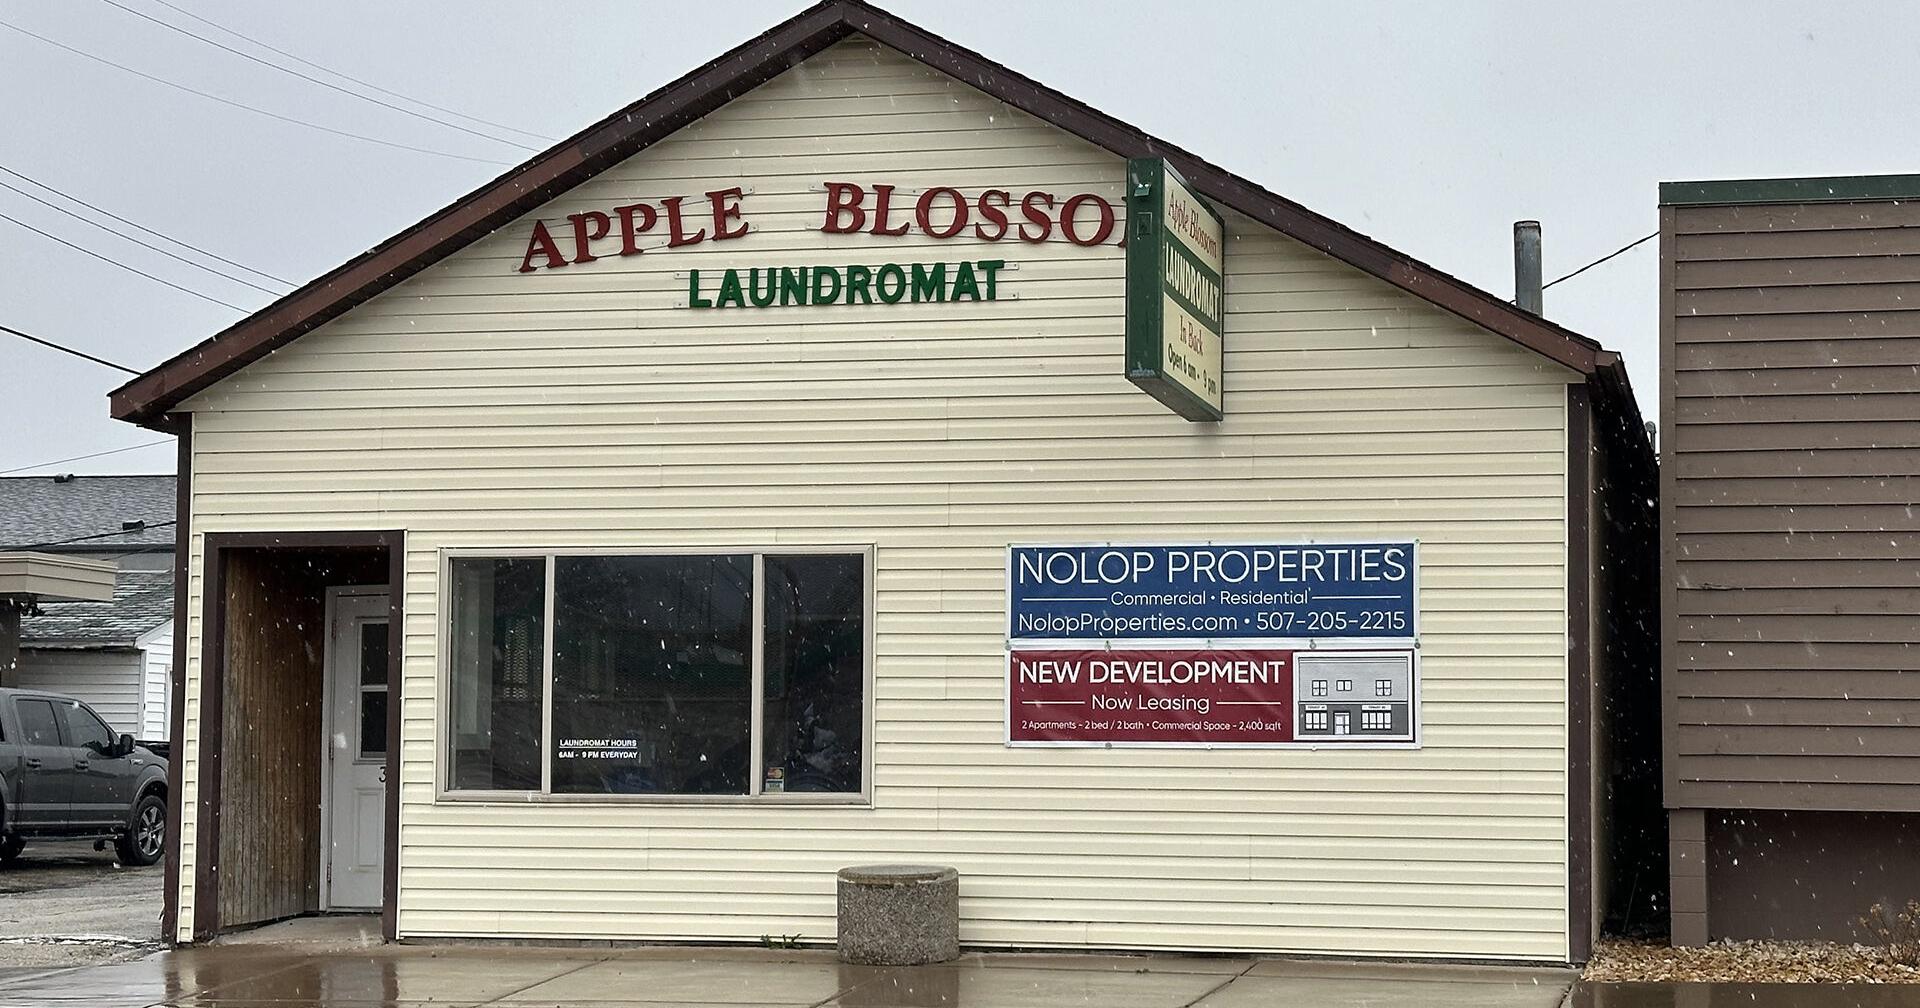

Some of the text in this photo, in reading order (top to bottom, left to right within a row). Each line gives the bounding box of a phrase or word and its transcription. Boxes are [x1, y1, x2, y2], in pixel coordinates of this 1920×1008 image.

[1168, 190, 1189, 233] Apple
[519, 181, 1128, 273] APPLE BLOSSO
[689, 259, 1005, 309] LAUNDROMAT
[1166, 241, 1220, 322] LAUNDROMAT
[1019, 548, 1406, 583] NOLOP PROPERTIES
[1111, 590, 1206, 606] Commercial
[1220, 590, 1308, 605] Residential
[1019, 612, 1238, 635] NolopProperties.com
[1256, 611, 1406, 631] 507-205-2215
[1019, 660, 1285, 684] NEW DEVELOPMENT
[1092, 694, 1210, 714] Now Leasing
[1022, 721, 1028, 730] 2
[1028, 720, 1077, 731] Apartments
[1084, 720, 1090, 729] 2
[1091, 720, 1109, 730] bed
[1116, 720, 1122, 730] 2
[1123, 720, 1144, 730] bath
[1152, 720, 1201, 730] Commercial
[1203, 721, 1231, 731] Space
